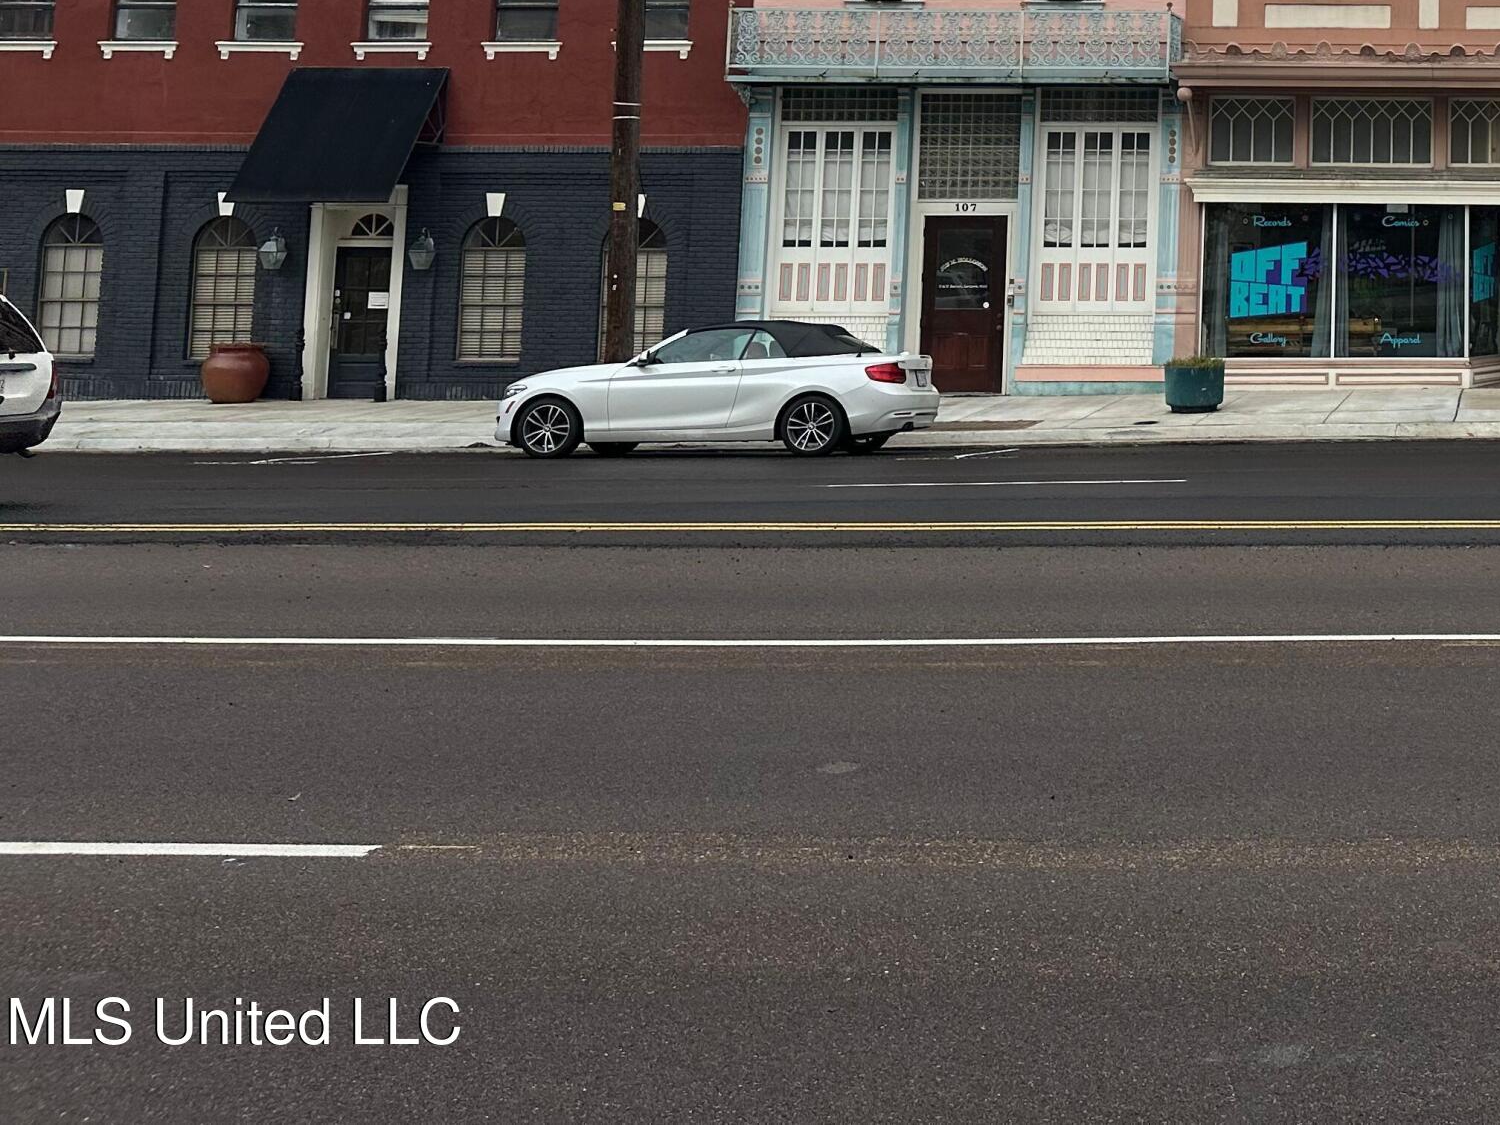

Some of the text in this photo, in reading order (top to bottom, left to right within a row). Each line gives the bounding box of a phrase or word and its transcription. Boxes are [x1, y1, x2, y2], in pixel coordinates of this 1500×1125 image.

[955, 203, 977, 212] 107
[1252, 215, 1293, 227] Records
[1381, 215, 1421, 227] Comics
[1231, 241, 1308, 285] OFF
[1230, 280, 1305, 318] BEAT
[1249, 332, 1288, 348] Gallery
[1379, 332, 1422, 349] Apparel
